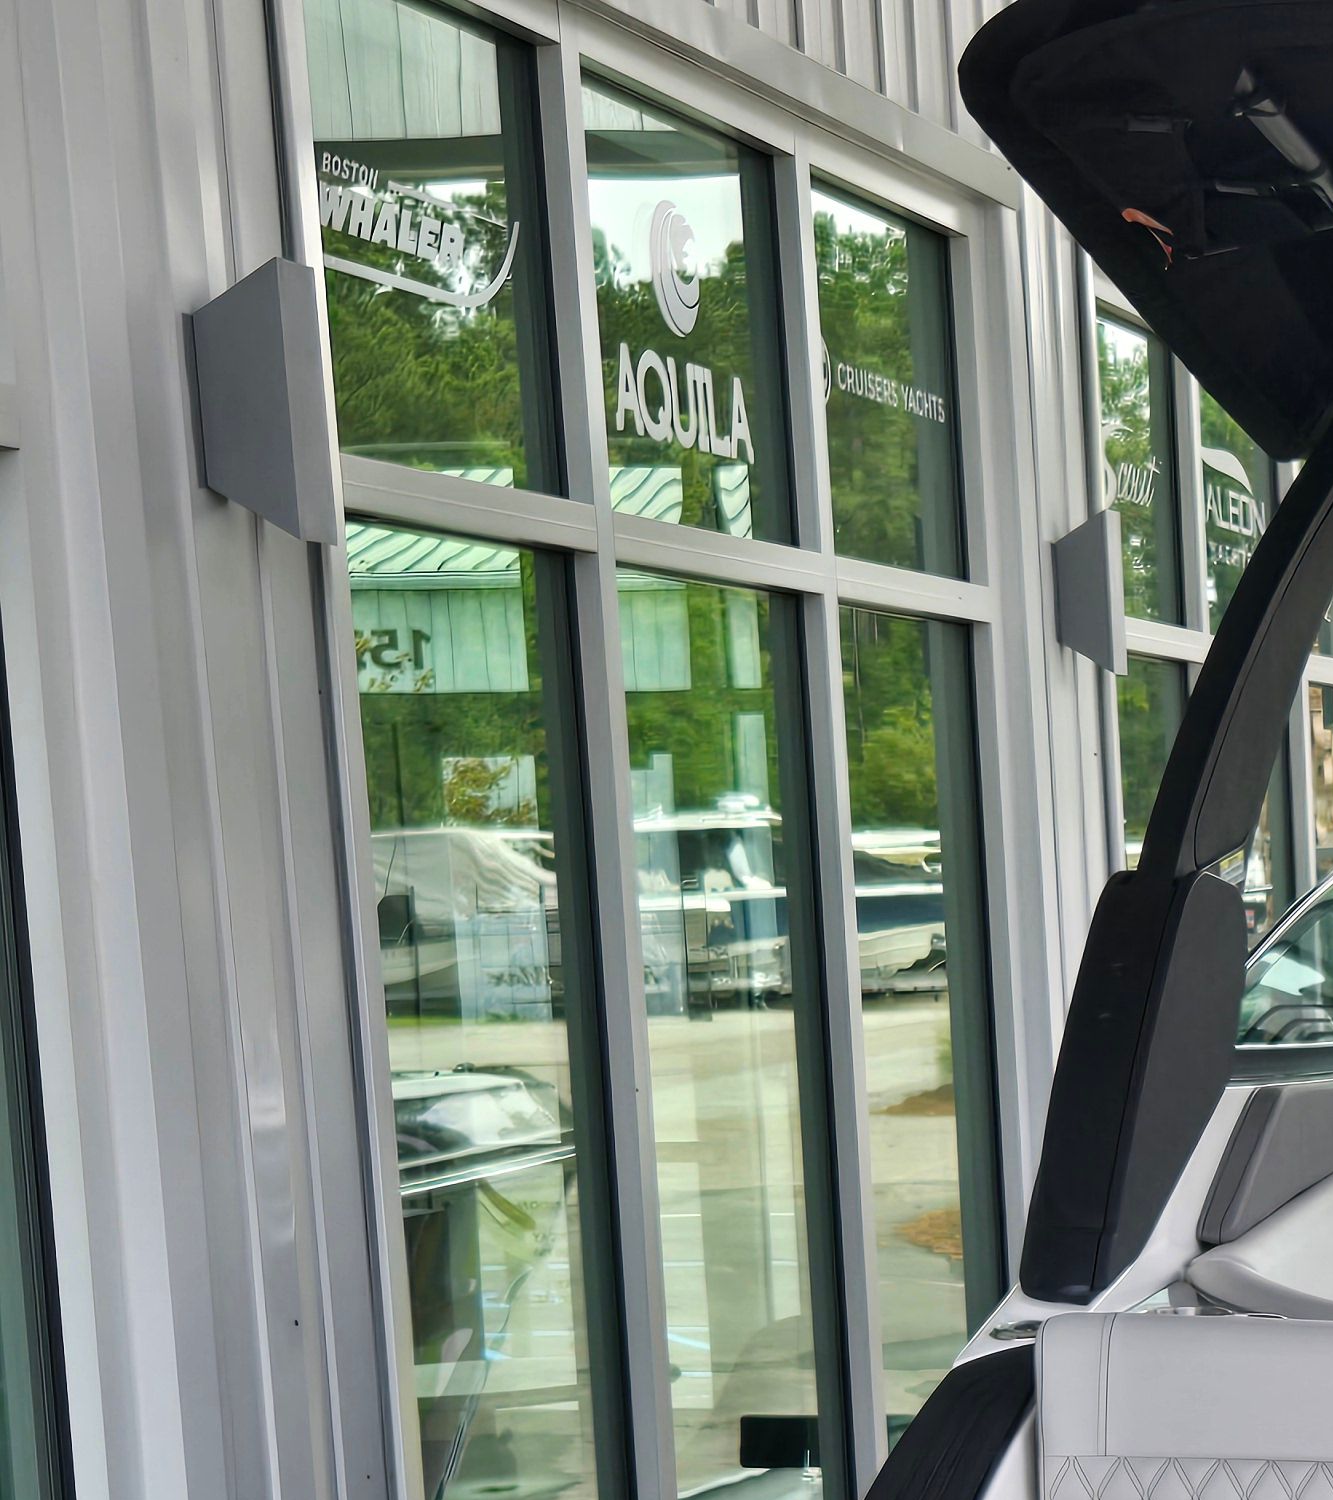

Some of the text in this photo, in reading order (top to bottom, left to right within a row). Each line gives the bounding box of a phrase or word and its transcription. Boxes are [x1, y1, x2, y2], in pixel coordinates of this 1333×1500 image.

[322, 152, 379, 189] BOSTON
[319, 183, 465, 267] WHALER
[616, 342, 755, 464] AQUILA
[837, 362, 946, 423] CRUISERS YACHTS
